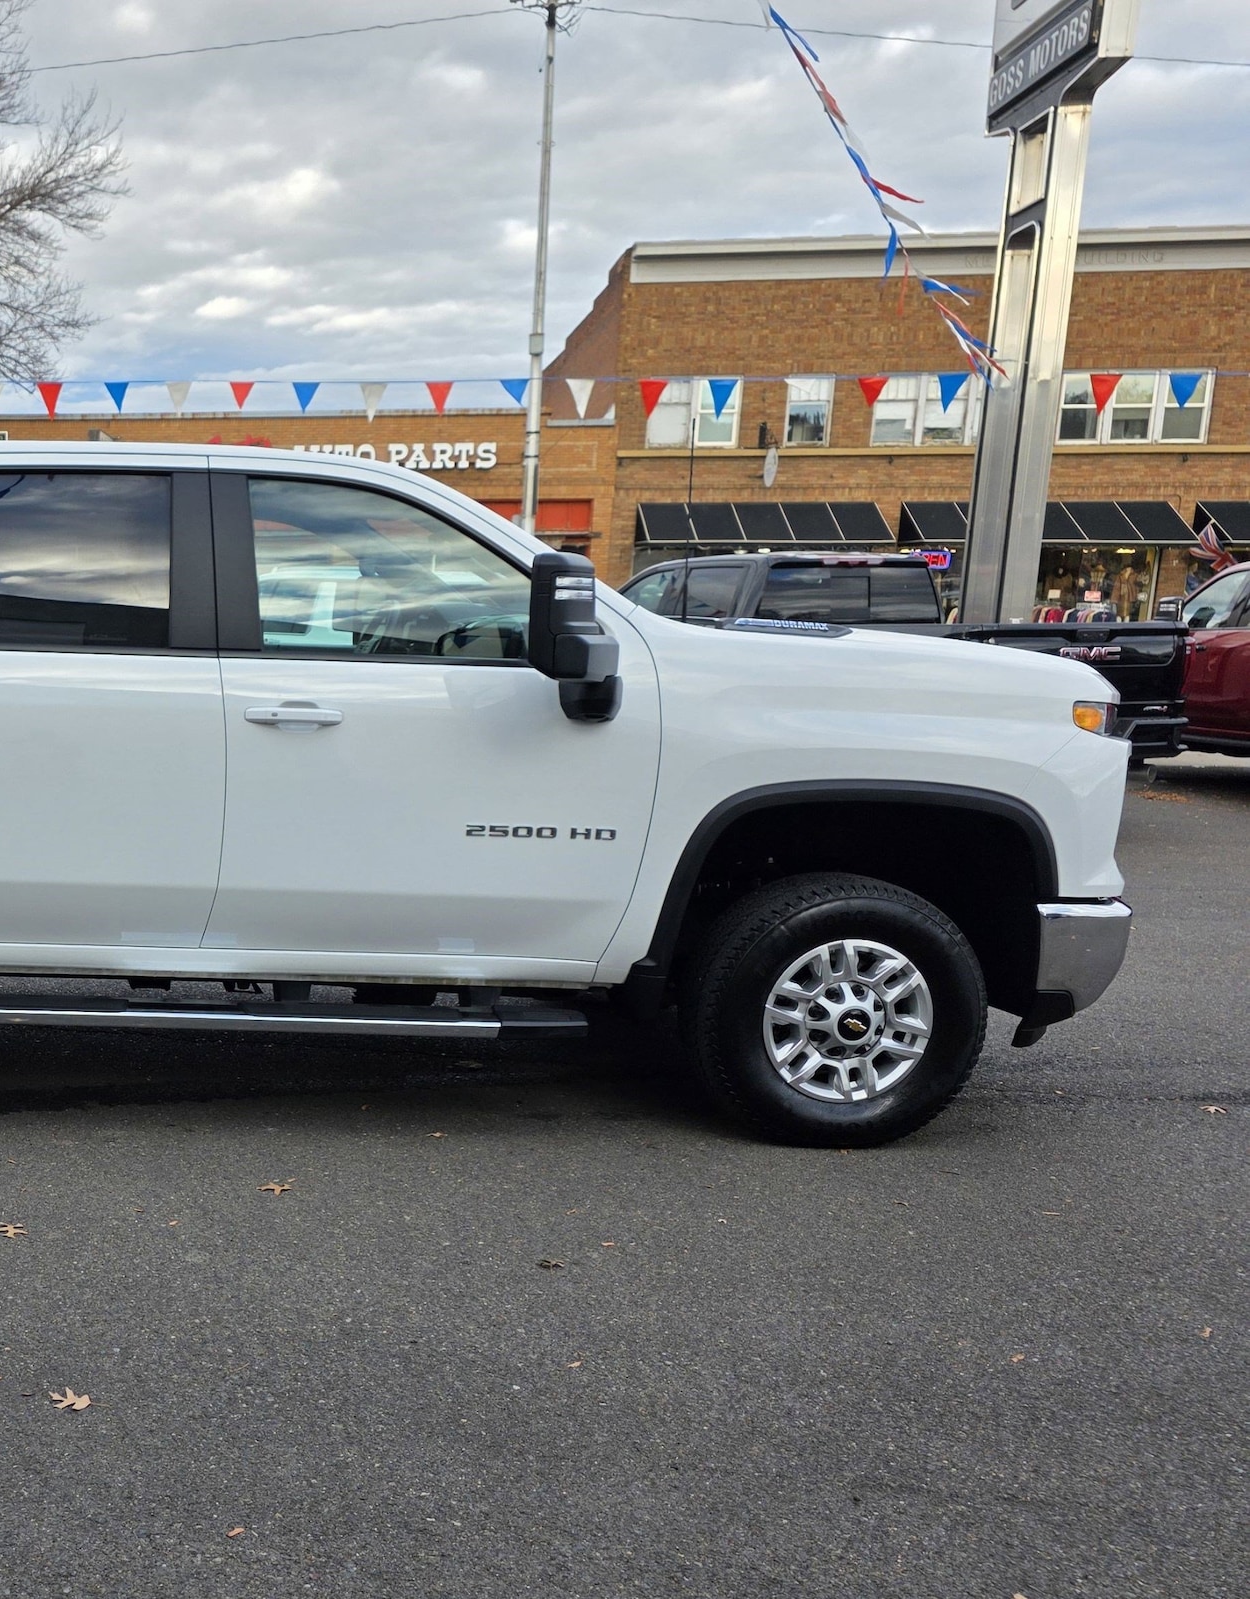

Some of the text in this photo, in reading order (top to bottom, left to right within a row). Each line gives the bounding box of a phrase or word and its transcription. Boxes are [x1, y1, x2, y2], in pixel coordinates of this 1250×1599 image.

[990, 9, 1089, 107] GOSS MOTORS
[388, 442, 498, 470] PARTS
[913, 552, 948, 567] PEN
[773, 619, 829, 631] DURAMAX
[1059, 646, 1122, 661] GMC
[466, 824, 617, 841] 2500 HD
